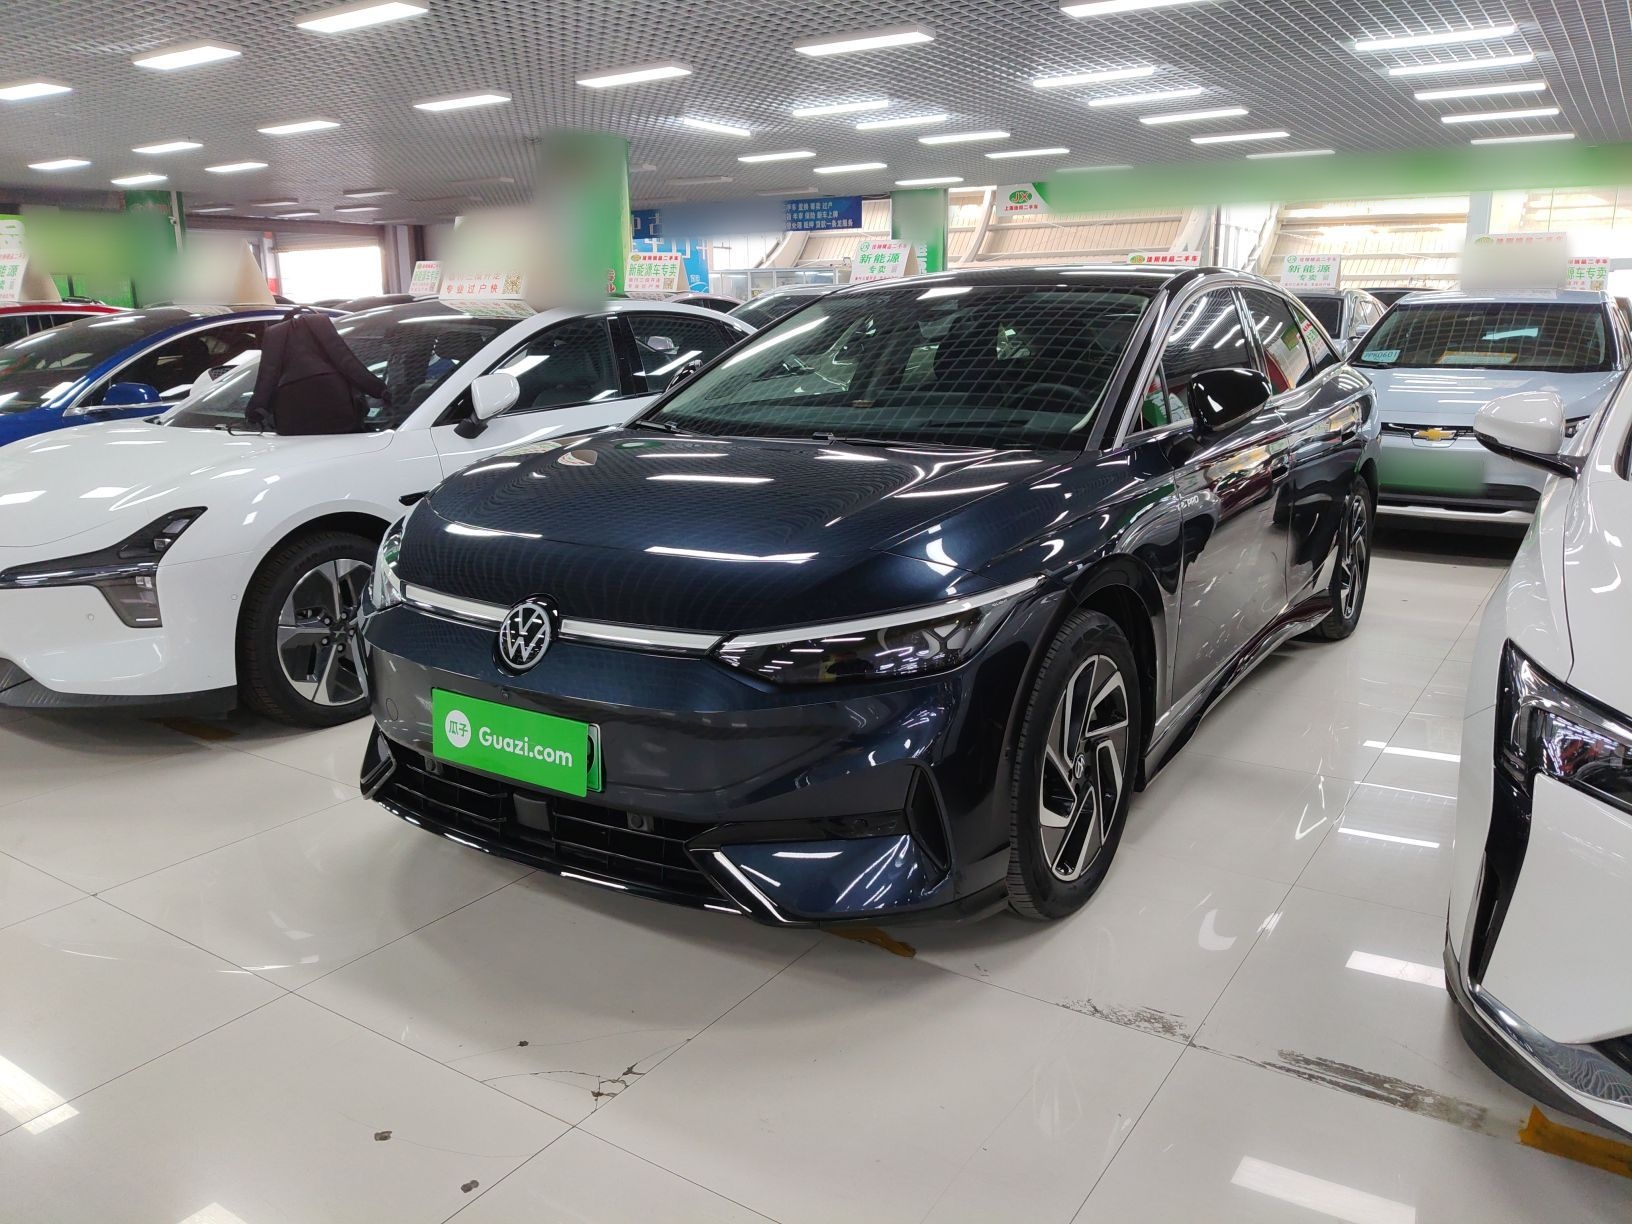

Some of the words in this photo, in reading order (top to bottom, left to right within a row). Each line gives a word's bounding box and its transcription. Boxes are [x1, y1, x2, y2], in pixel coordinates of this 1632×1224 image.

[859, 253, 901, 265] 新能源
[629, 263, 677, 277] 新能源车专卖
[869, 266, 887, 274] 专卖
[1288, 265, 1332, 273] 新能源
[446, 283, 499, 294] 专业过户快
[448, 719, 469, 738] 瓜子
[478, 726, 573, 768] Guazi.com
